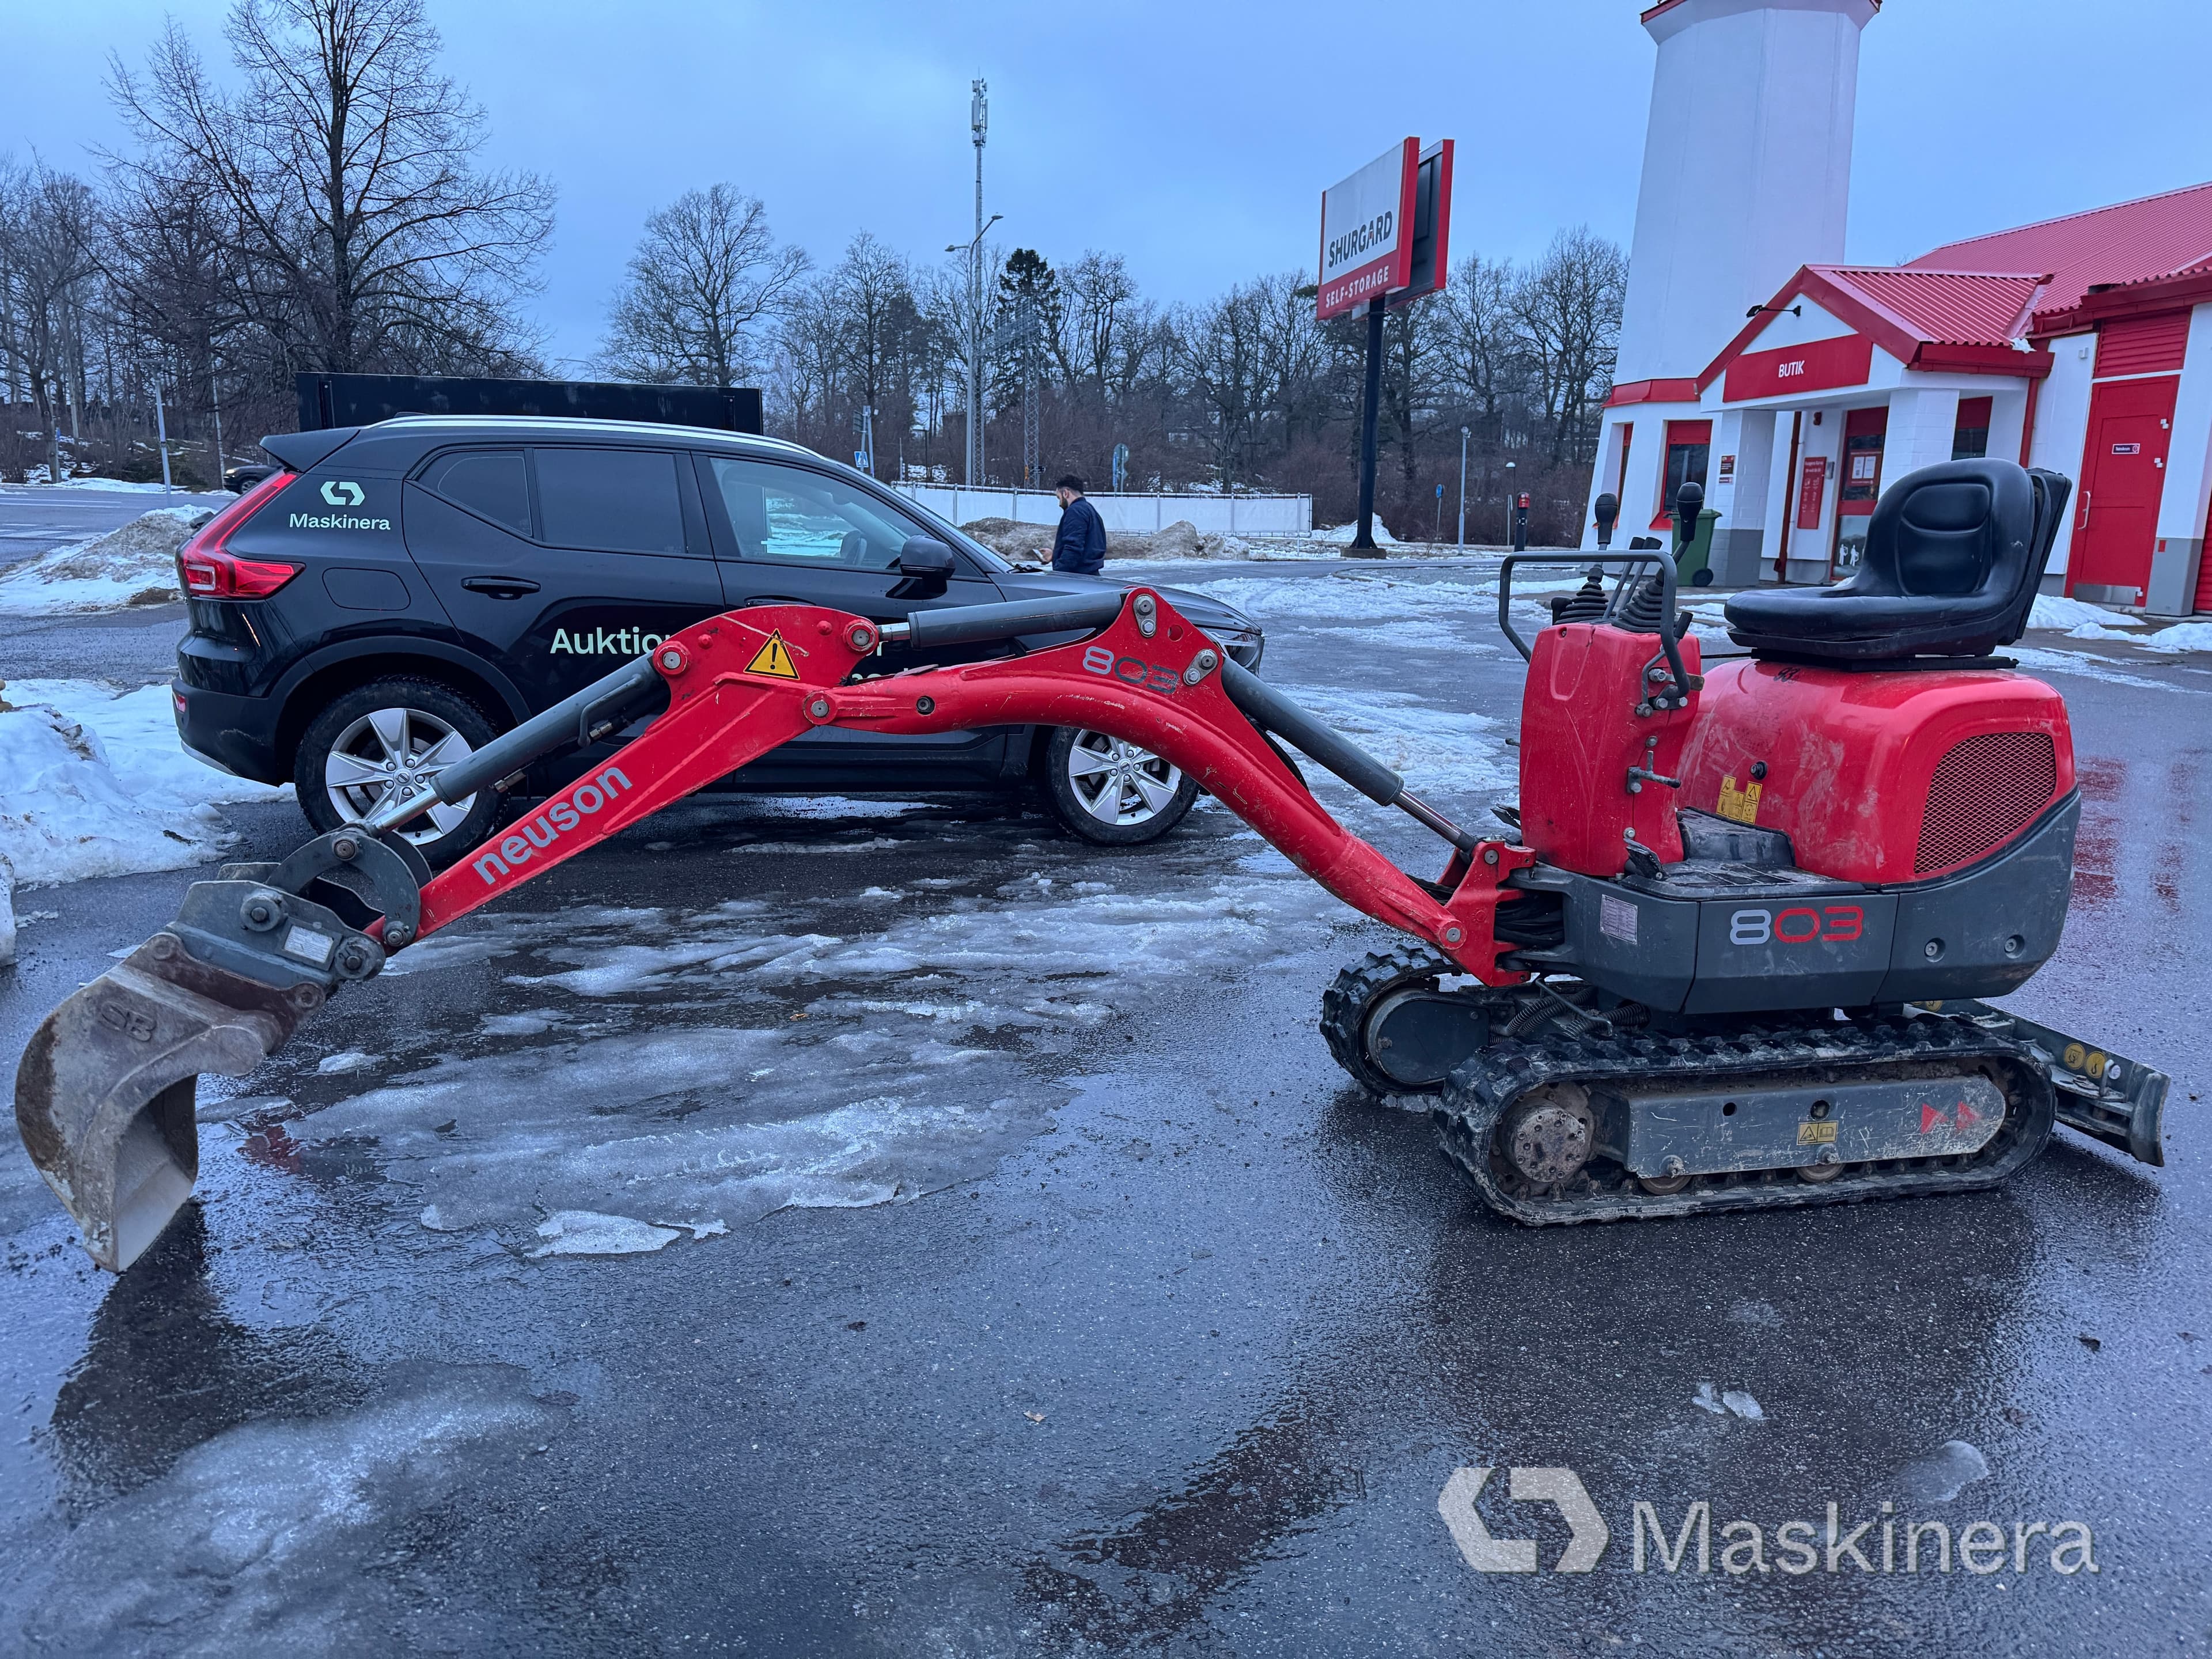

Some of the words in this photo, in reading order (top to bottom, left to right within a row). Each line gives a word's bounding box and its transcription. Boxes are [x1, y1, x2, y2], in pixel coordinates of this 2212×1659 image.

[1328, 211, 1393, 268] SHURGARD
[1326, 266, 1389, 308] SELF-STORAGE
[1779, 360, 1805, 378] BUTIK
[289, 513, 391, 531] Maskinera
[550, 626, 671, 655] Auktio
[1083, 646, 1179, 694] 803
[472, 767, 632, 885] neuson
[1730, 906, 1863, 945] 803
